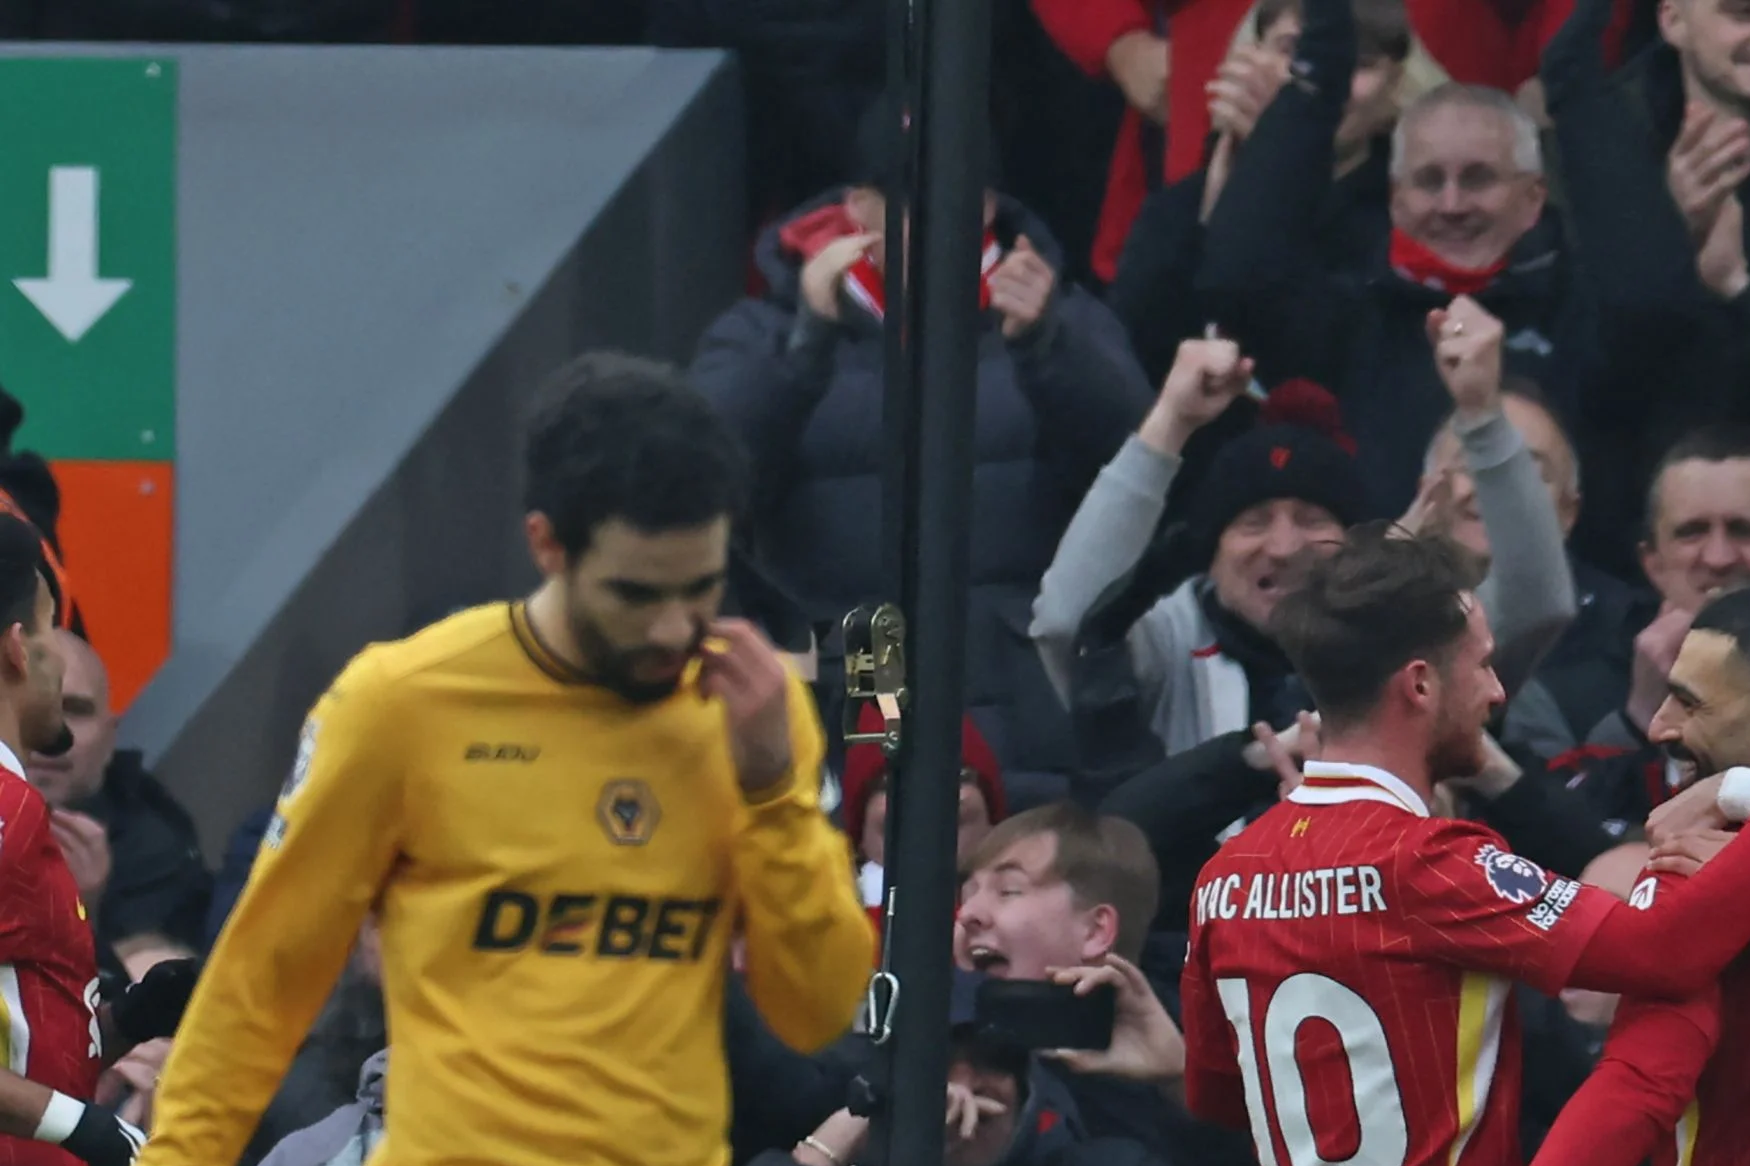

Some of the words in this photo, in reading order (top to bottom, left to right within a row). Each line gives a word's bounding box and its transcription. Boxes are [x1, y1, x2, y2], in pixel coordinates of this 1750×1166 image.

[1242, 865, 1388, 920] ALLISTER
[1526, 903, 1549, 924] No
[1544, 879, 1567, 905] room
[472, 890, 720, 961] DEBET
